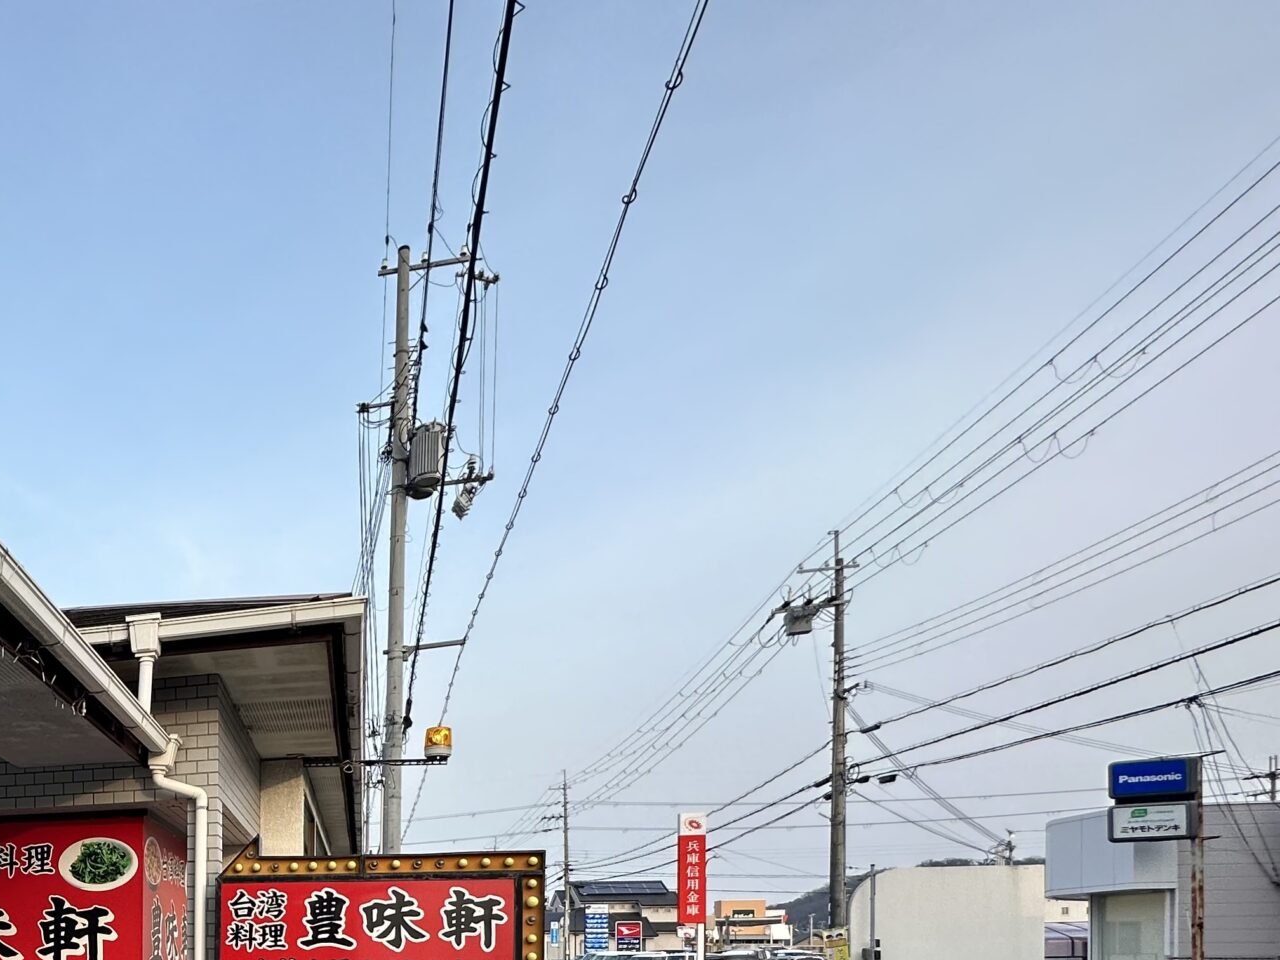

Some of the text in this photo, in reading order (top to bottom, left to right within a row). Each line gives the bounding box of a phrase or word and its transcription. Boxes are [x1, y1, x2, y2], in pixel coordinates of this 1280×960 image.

[1118, 772, 1183, 783] Panasonic
[1120, 824, 1181, 834] ミヤモトデンキ
[686, 840, 700, 916] 兵庫信用金庫
[228, 889, 288, 919] 台湾
[297, 886, 508, 953] 豊味軒
[227, 922, 288, 952] 料理
